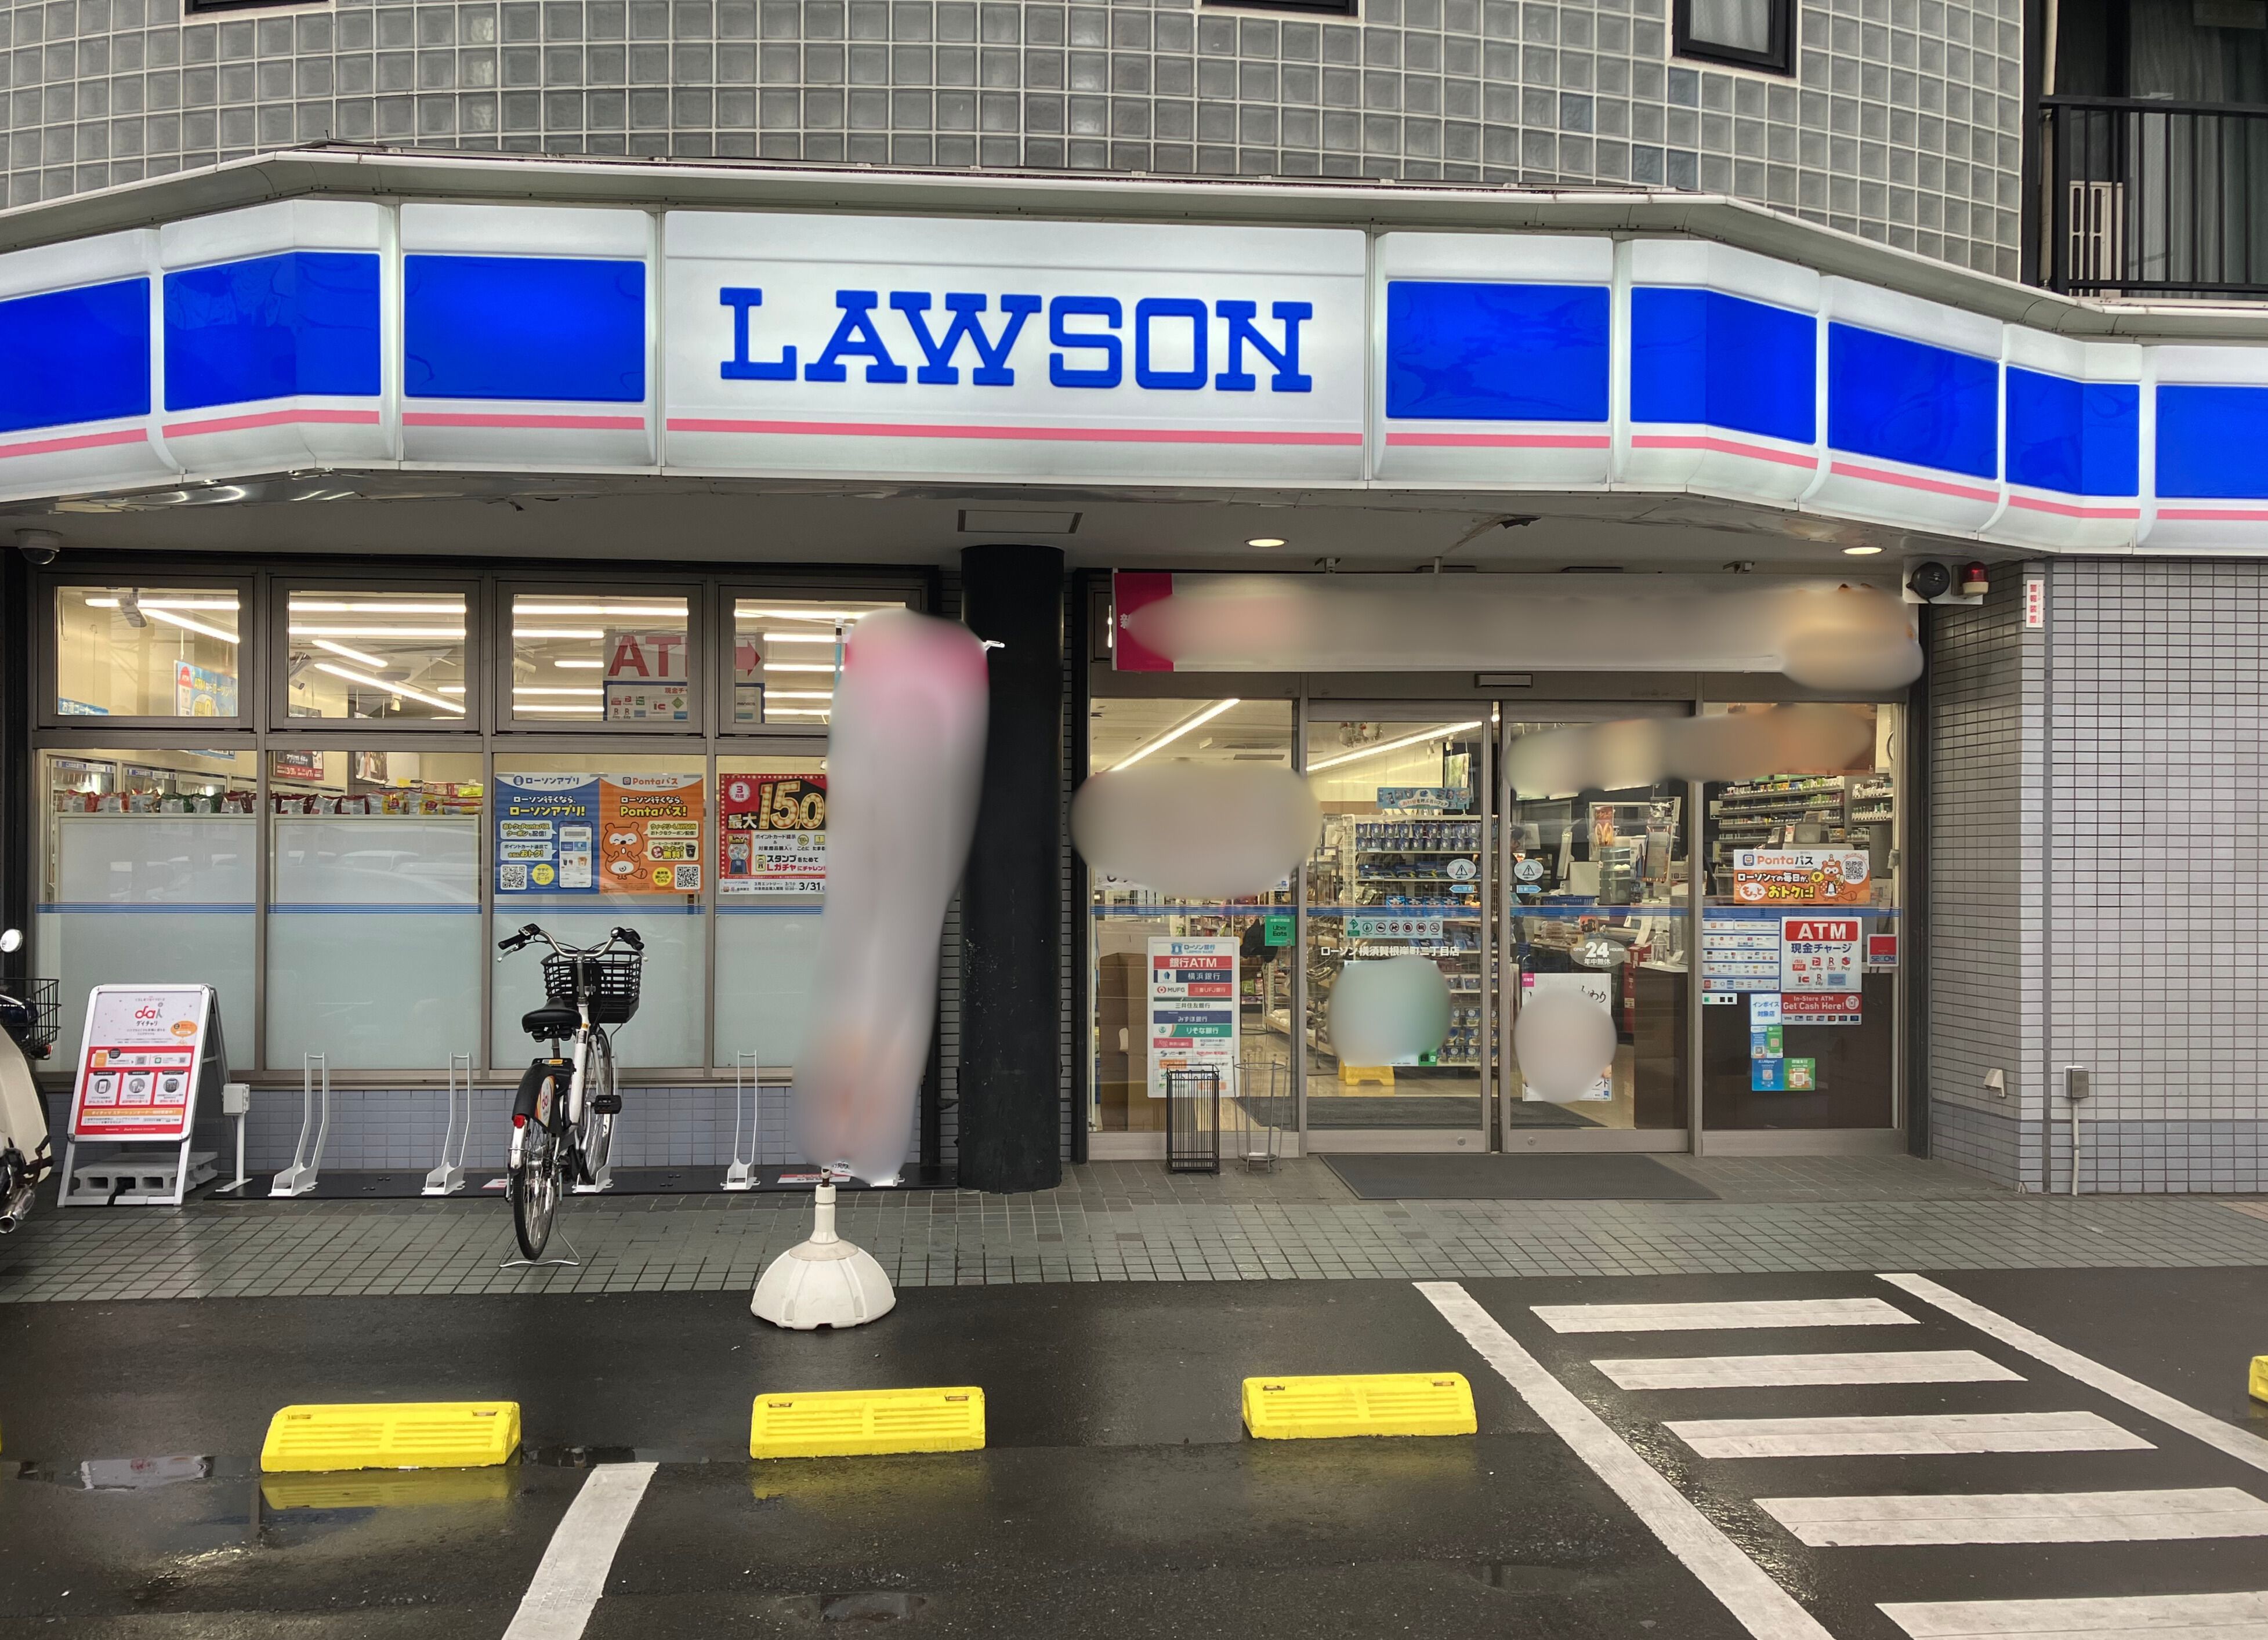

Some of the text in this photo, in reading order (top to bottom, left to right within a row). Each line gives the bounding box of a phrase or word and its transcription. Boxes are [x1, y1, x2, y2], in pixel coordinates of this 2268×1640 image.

[720, 288, 1312, 392] LAWSON
[608, 636, 687, 677] AT
[526, 777, 579, 785] ローソンアプリ
[513, 796, 577, 804] ローソン行くなら、
[509, 805, 585, 817] ローソンアプリ!
[620, 806, 687, 817] Pontaパス!
[728, 813, 757, 829] 最大
[1758, 855, 1814, 865] Pontaパス
[767, 863, 825, 871] Lガチャにチャレン
[799, 882, 821, 891] 3/31
[1767, 885, 1814, 898] おトクに!
[1798, 923, 1846, 939] ATM
[1585, 942, 1610, 958] 24
[1169, 958, 1217, 968] 銀行ATM
